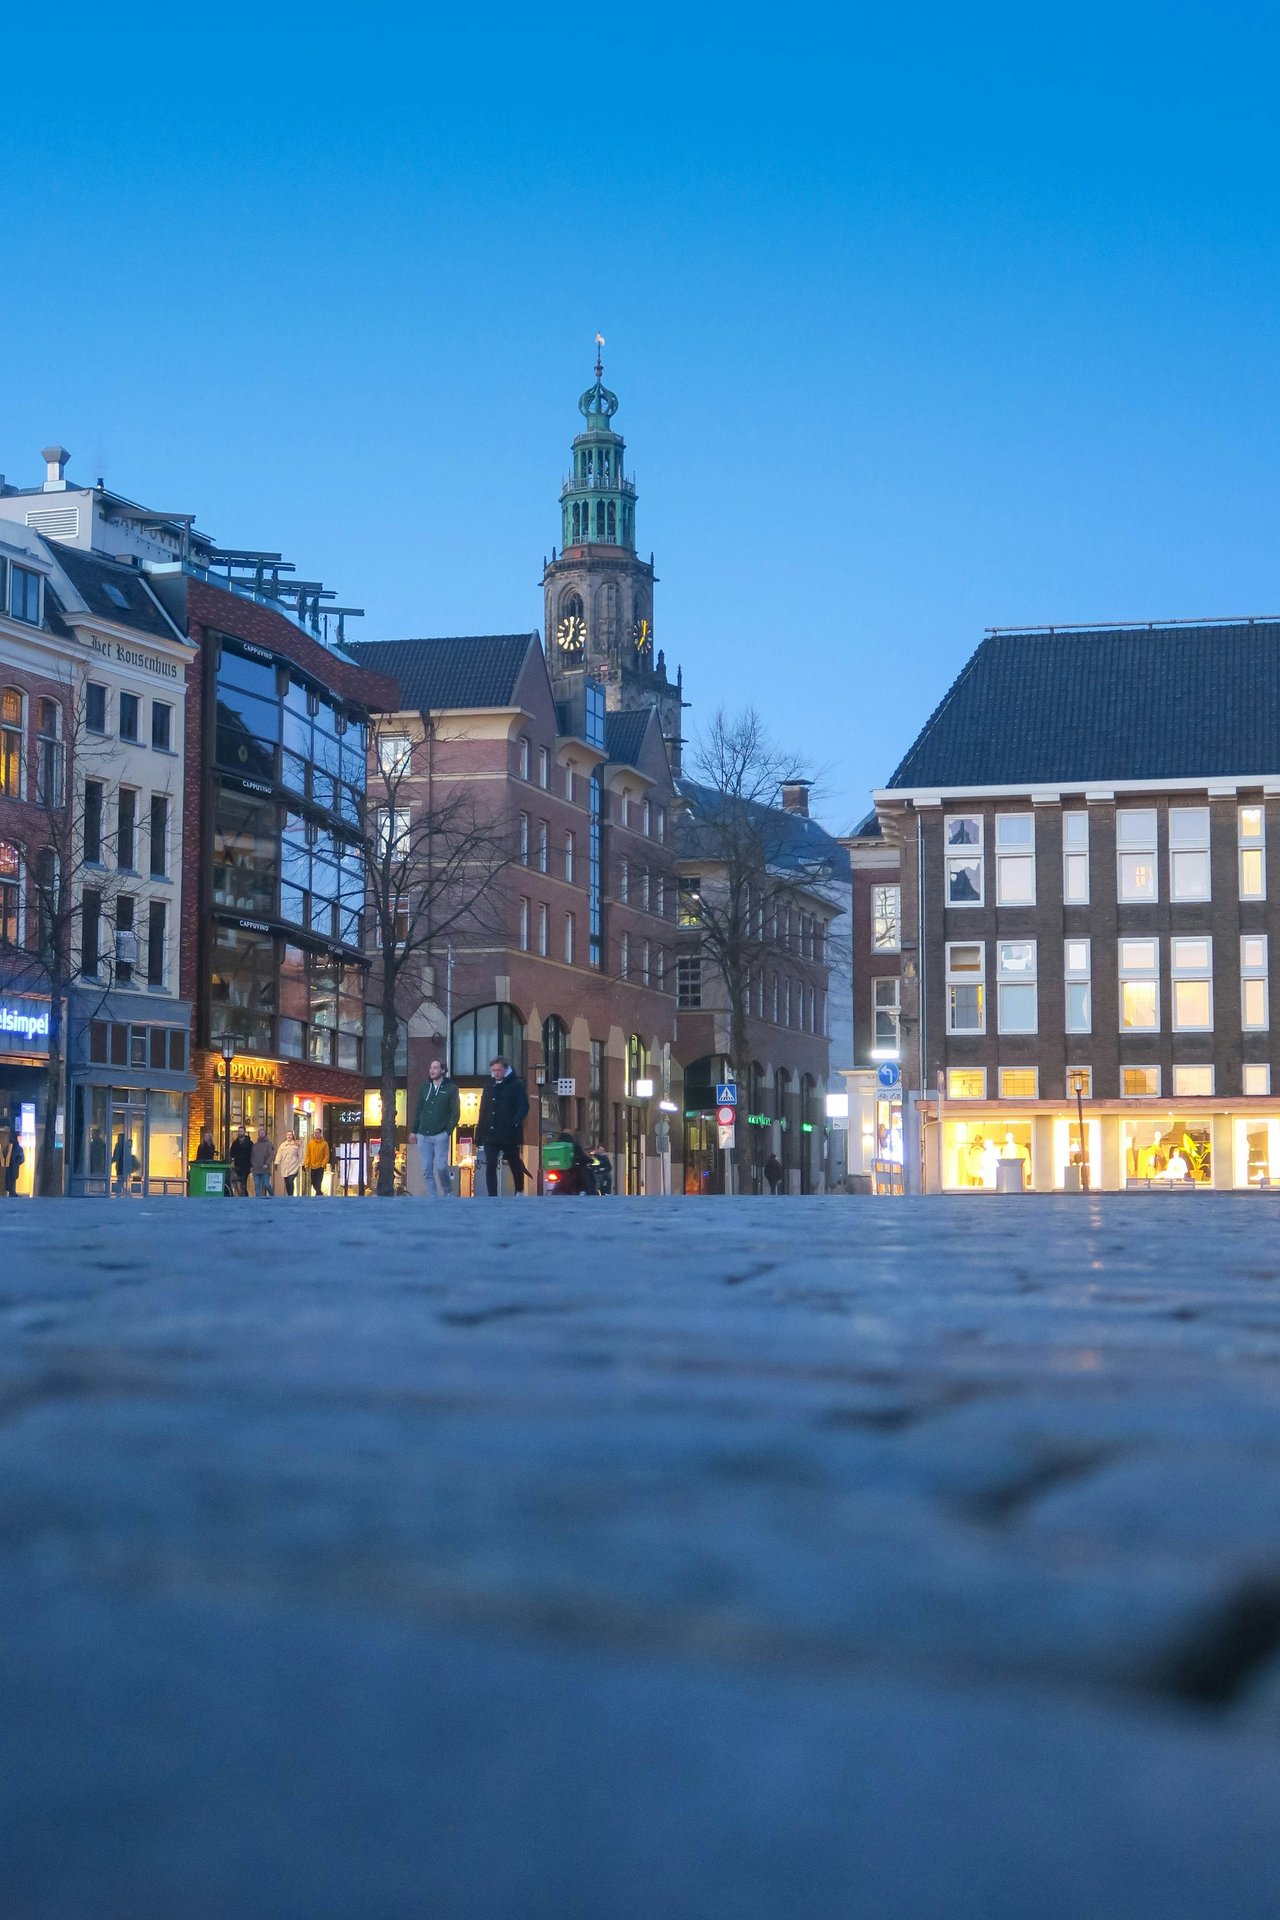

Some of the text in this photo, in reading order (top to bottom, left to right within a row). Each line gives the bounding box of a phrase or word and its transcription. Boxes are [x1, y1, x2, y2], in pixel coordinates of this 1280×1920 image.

[91, 635, 178, 678] Het Rousenhuis
[243, 643, 273, 660] CAPPUVINO
[242, 780, 272, 794] CAPPUVINO
[239, 920, 269, 931] CAPPUVINO
